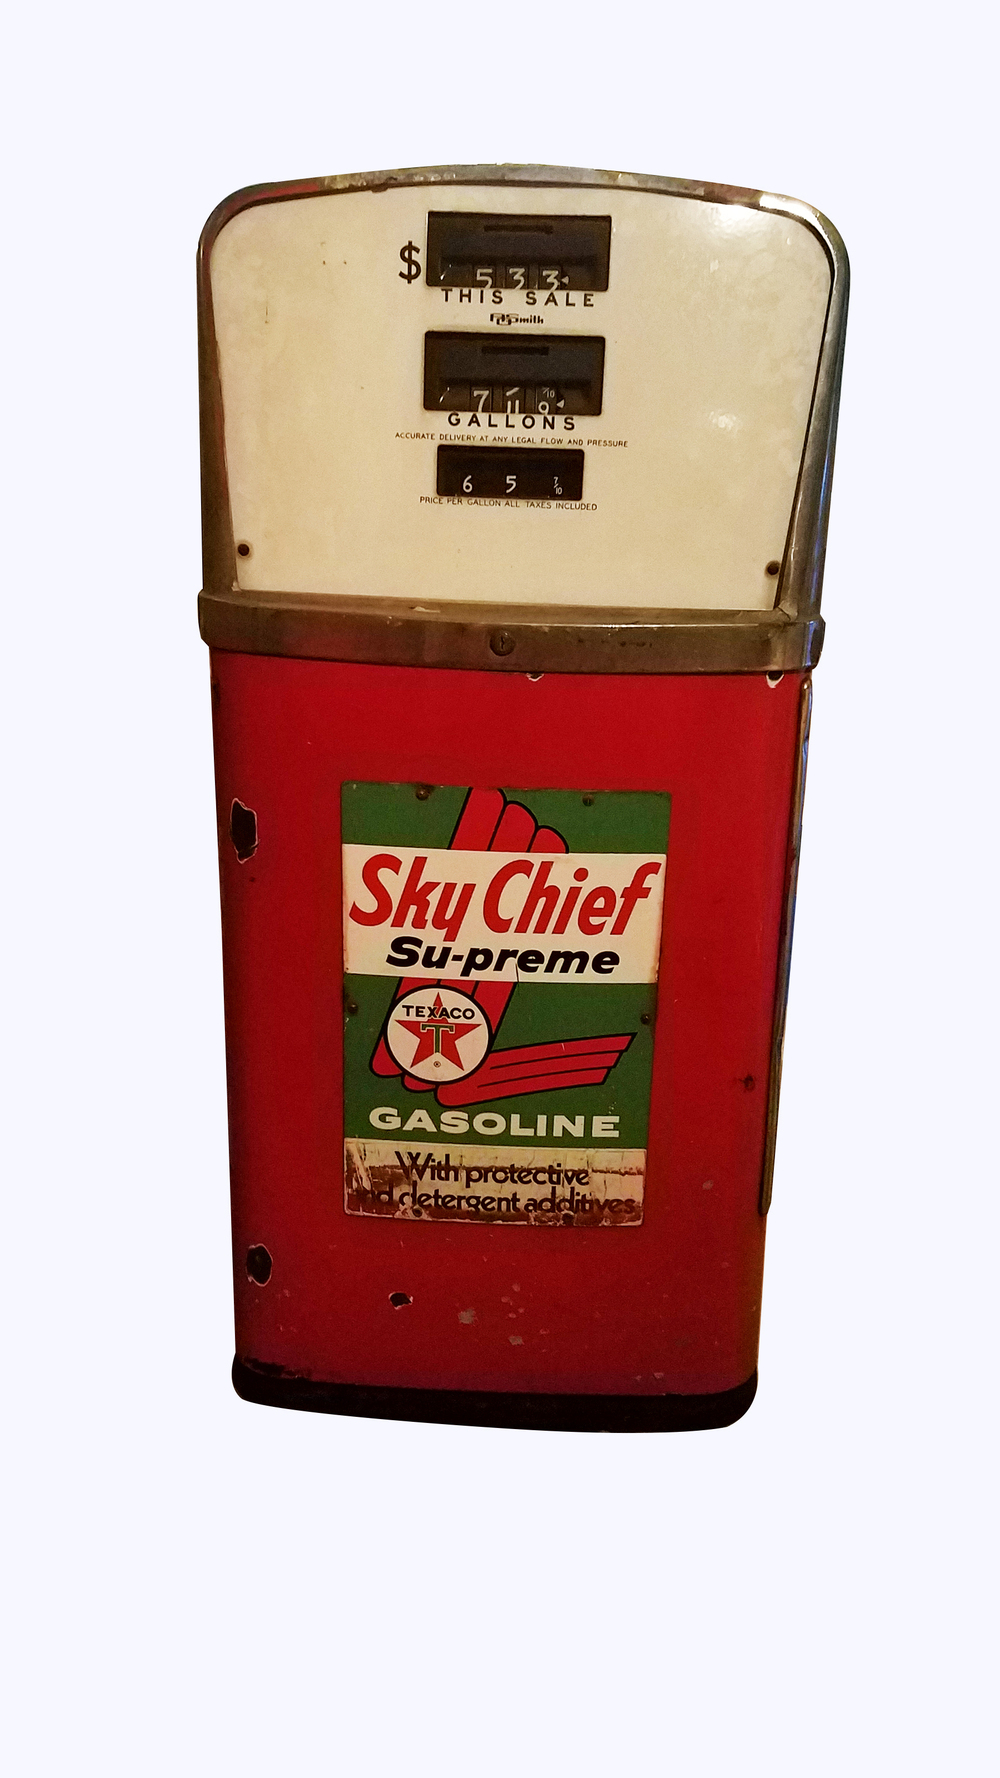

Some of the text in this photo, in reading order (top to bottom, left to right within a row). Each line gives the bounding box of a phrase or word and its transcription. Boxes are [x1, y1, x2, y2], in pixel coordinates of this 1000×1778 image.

[398, 240, 422, 284] $
[441, 288, 594, 308] THIS SALE
[447, 412, 576, 431] GALLONS
[394, 431, 629, 448] ACCURATE DELIVERY AT ANY LEGAL FLOW AND PRESSURE
[419, 495, 599, 512] PRICE PER GALLON ALL TAXES INCLUDED
[348, 853, 662, 942] Sky Chief
[385, 935, 620, 978] Su-preme
[401, 1004, 476, 1020] TEXACO
[420, 1022, 455, 1054] T
[369, 1106, 621, 1139] GASOLINE
[394, 1150, 590, 1189] With protective
[399, 1180, 521, 1213] detergent
[524, 1186, 637, 1215] additives
